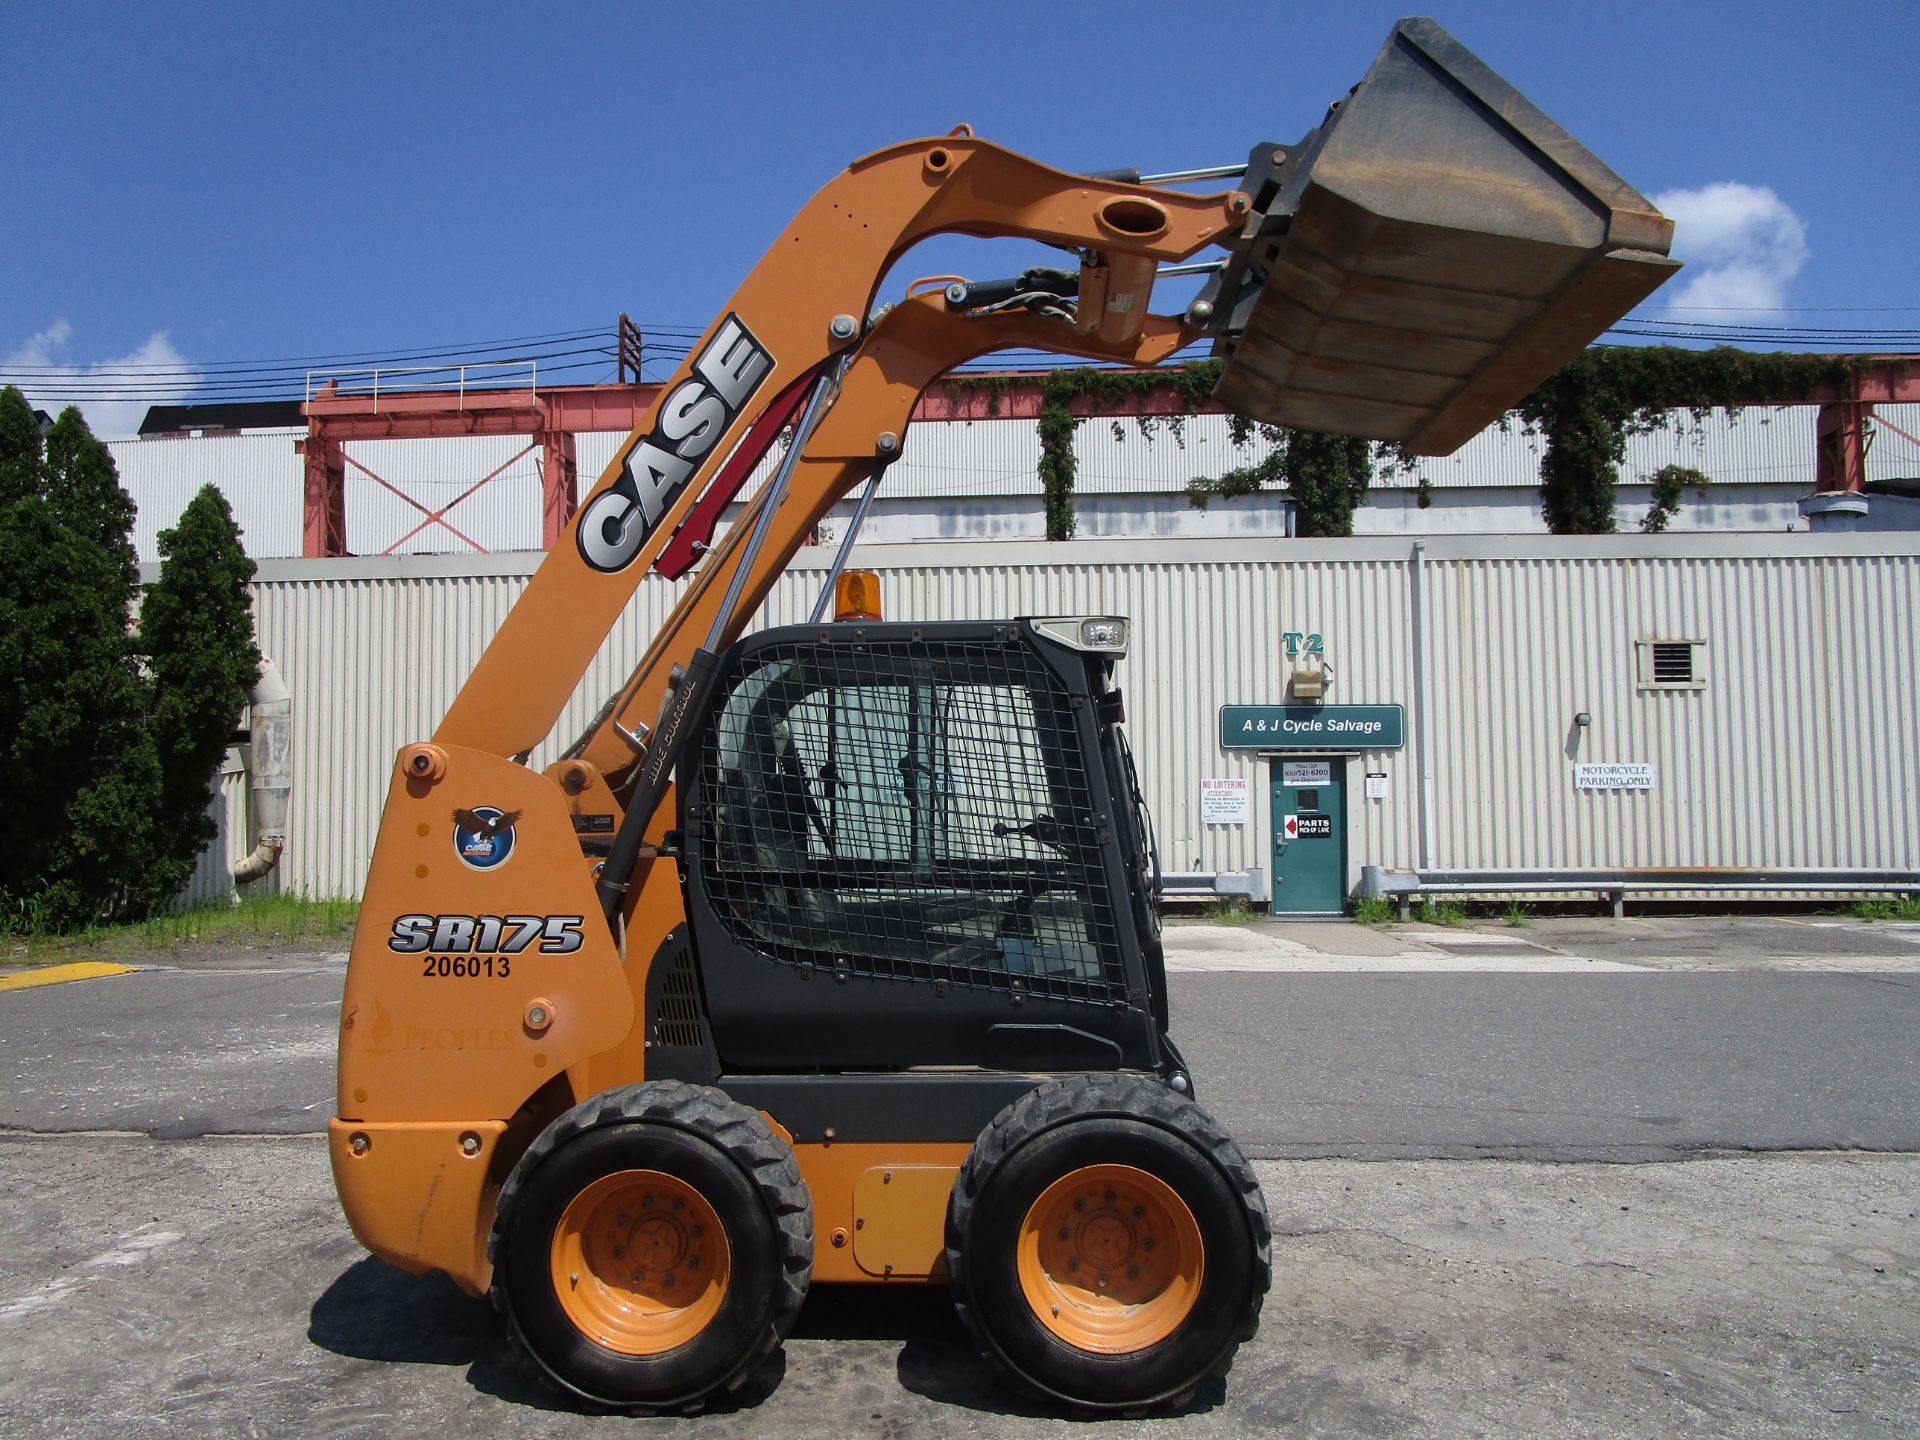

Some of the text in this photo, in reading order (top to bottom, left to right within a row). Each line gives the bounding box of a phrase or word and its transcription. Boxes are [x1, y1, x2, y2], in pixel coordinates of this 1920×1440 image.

[577, 312, 776, 573] CASE
[1242, 719, 1382, 734] A & J Cycle Salvage
[1582, 766, 1648, 775] MOTORCYCLE
[1203, 780, 1246, 789] NO LOITERING
[1580, 777, 1652, 786] PARKING ONLY
[1299, 819, 1329, 827] PARTS
[465, 844, 493, 852] CASE
[388, 914, 584, 953] SR175
[423, 956, 510, 977] 206013
